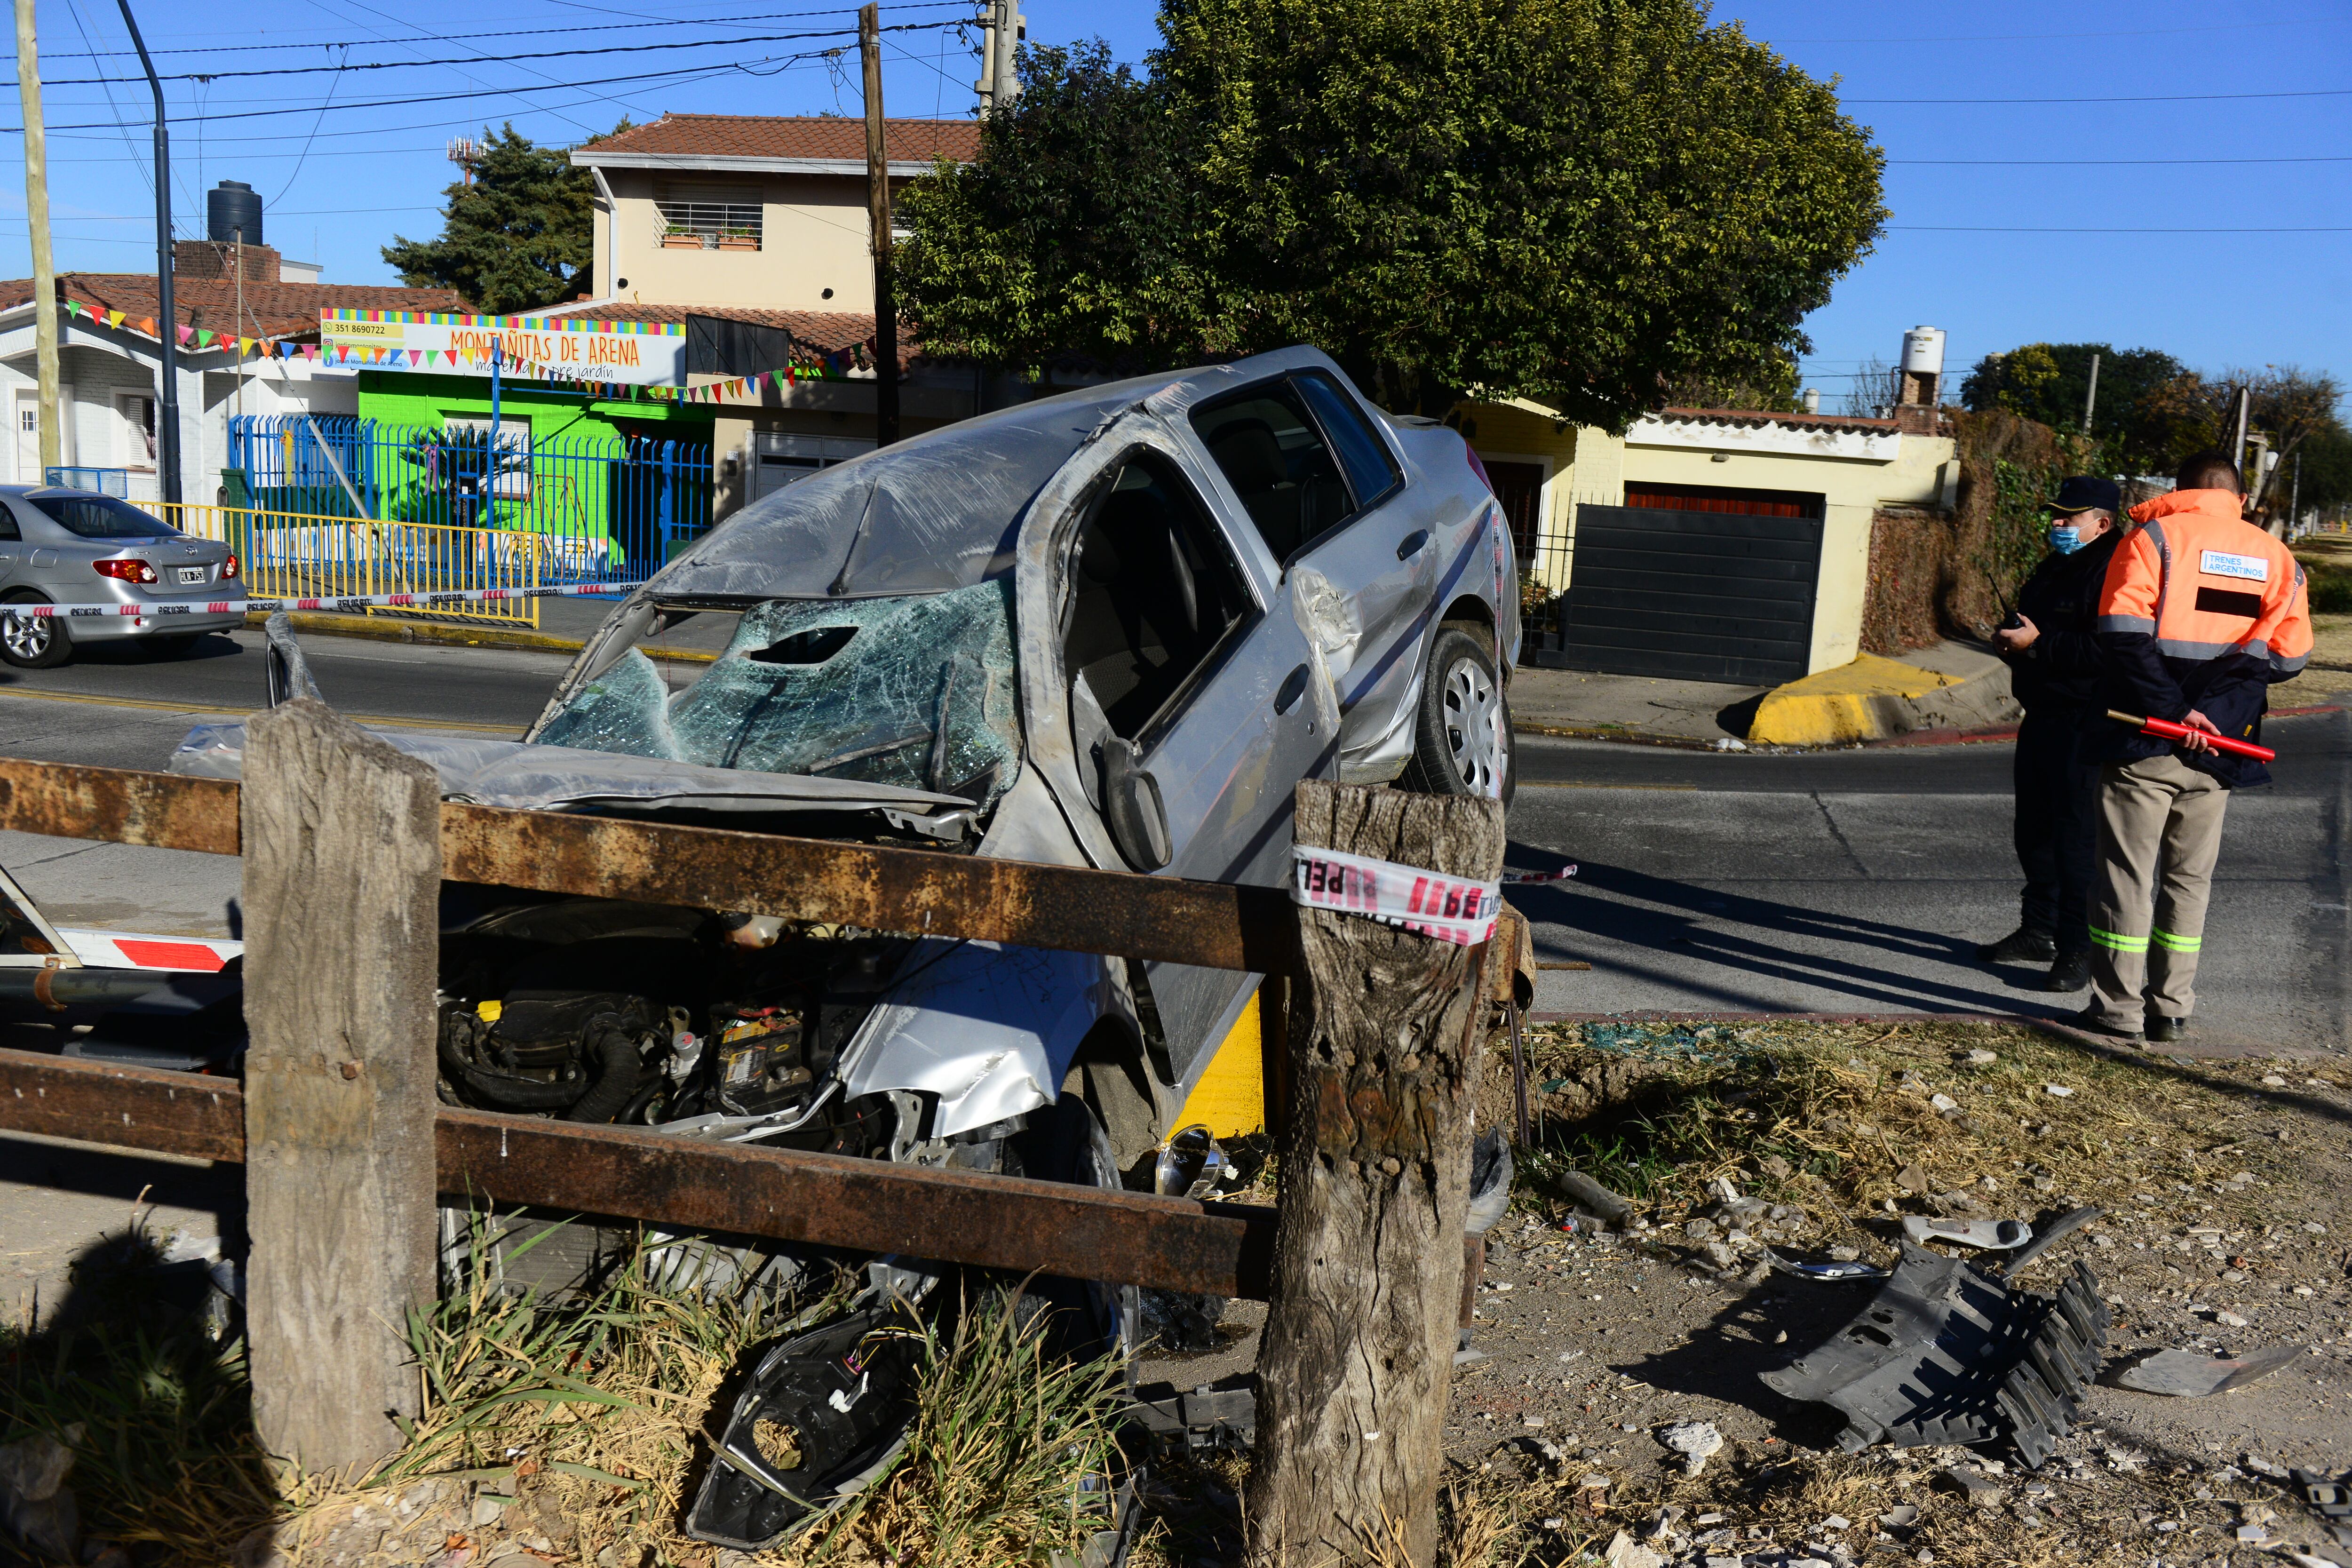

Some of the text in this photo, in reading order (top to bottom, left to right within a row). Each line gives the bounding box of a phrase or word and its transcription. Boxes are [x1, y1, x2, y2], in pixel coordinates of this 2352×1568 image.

[351, 325, 385, 334] 8690722
[451, 330, 640, 366] MONTAÑITAS DE ARENA
[577, 363, 613, 379] jardín
[2210, 555, 2241, 565] TRENES
[2209, 564, 2263, 577] ARGENTINOS
